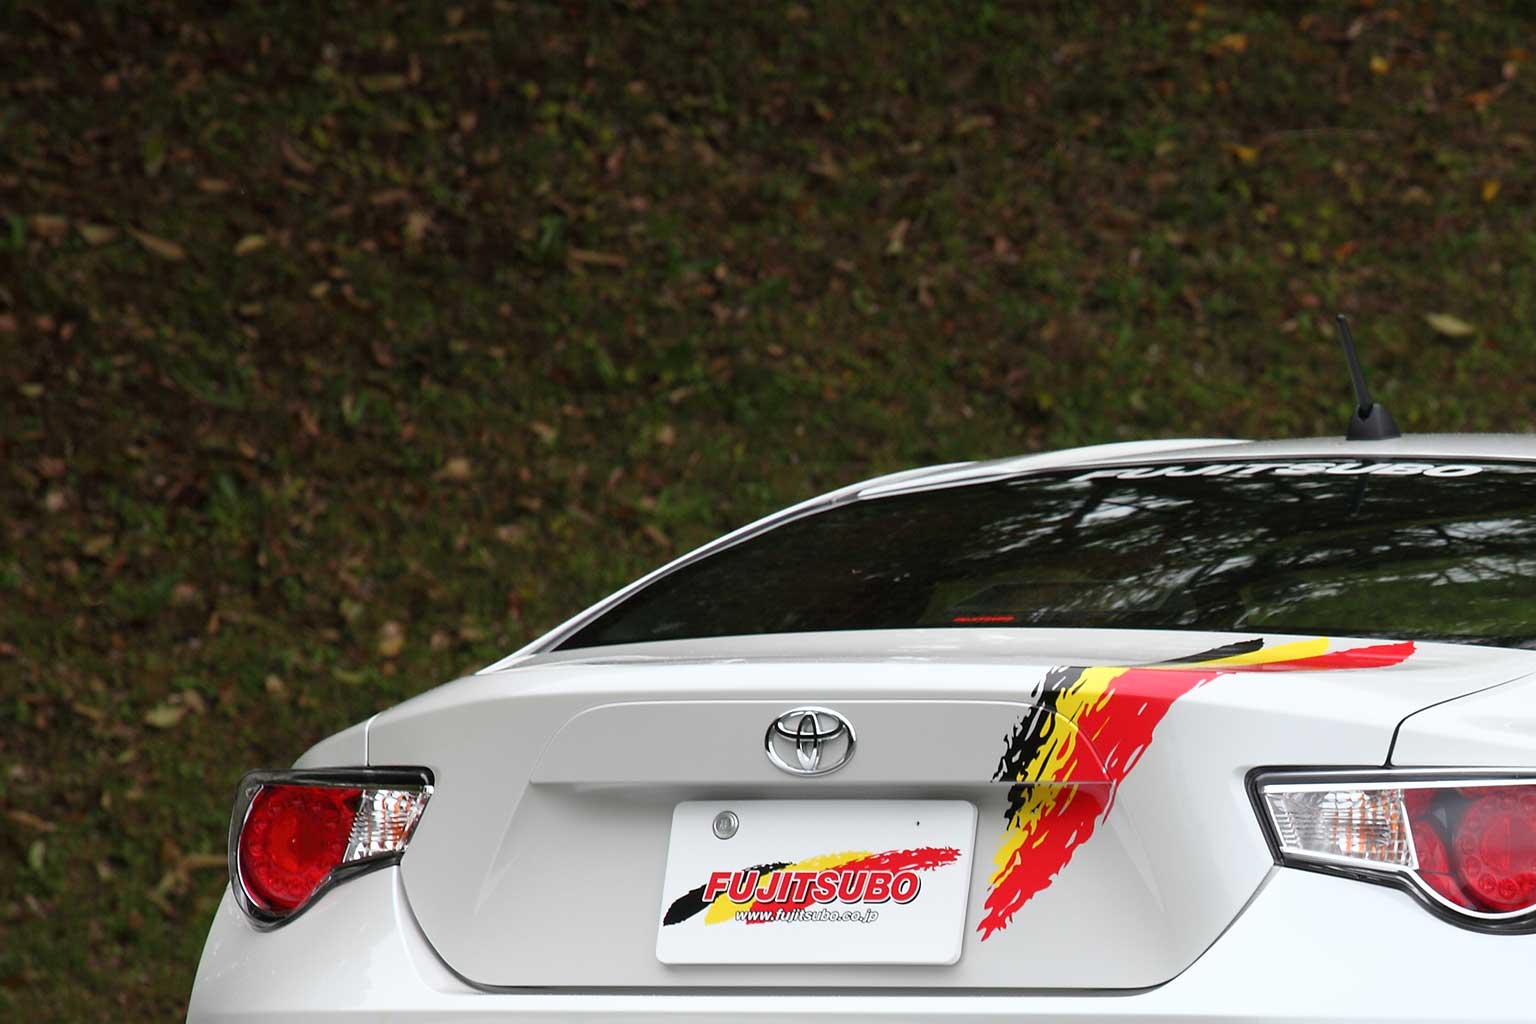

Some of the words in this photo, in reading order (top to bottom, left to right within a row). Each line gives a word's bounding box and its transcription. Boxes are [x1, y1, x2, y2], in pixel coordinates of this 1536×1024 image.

[1071, 462, 1483, 481] FUJITSUBO
[702, 870, 921, 904] FUJITSUBO
[734, 908, 879, 923] www.fujitsubo.co.jp
